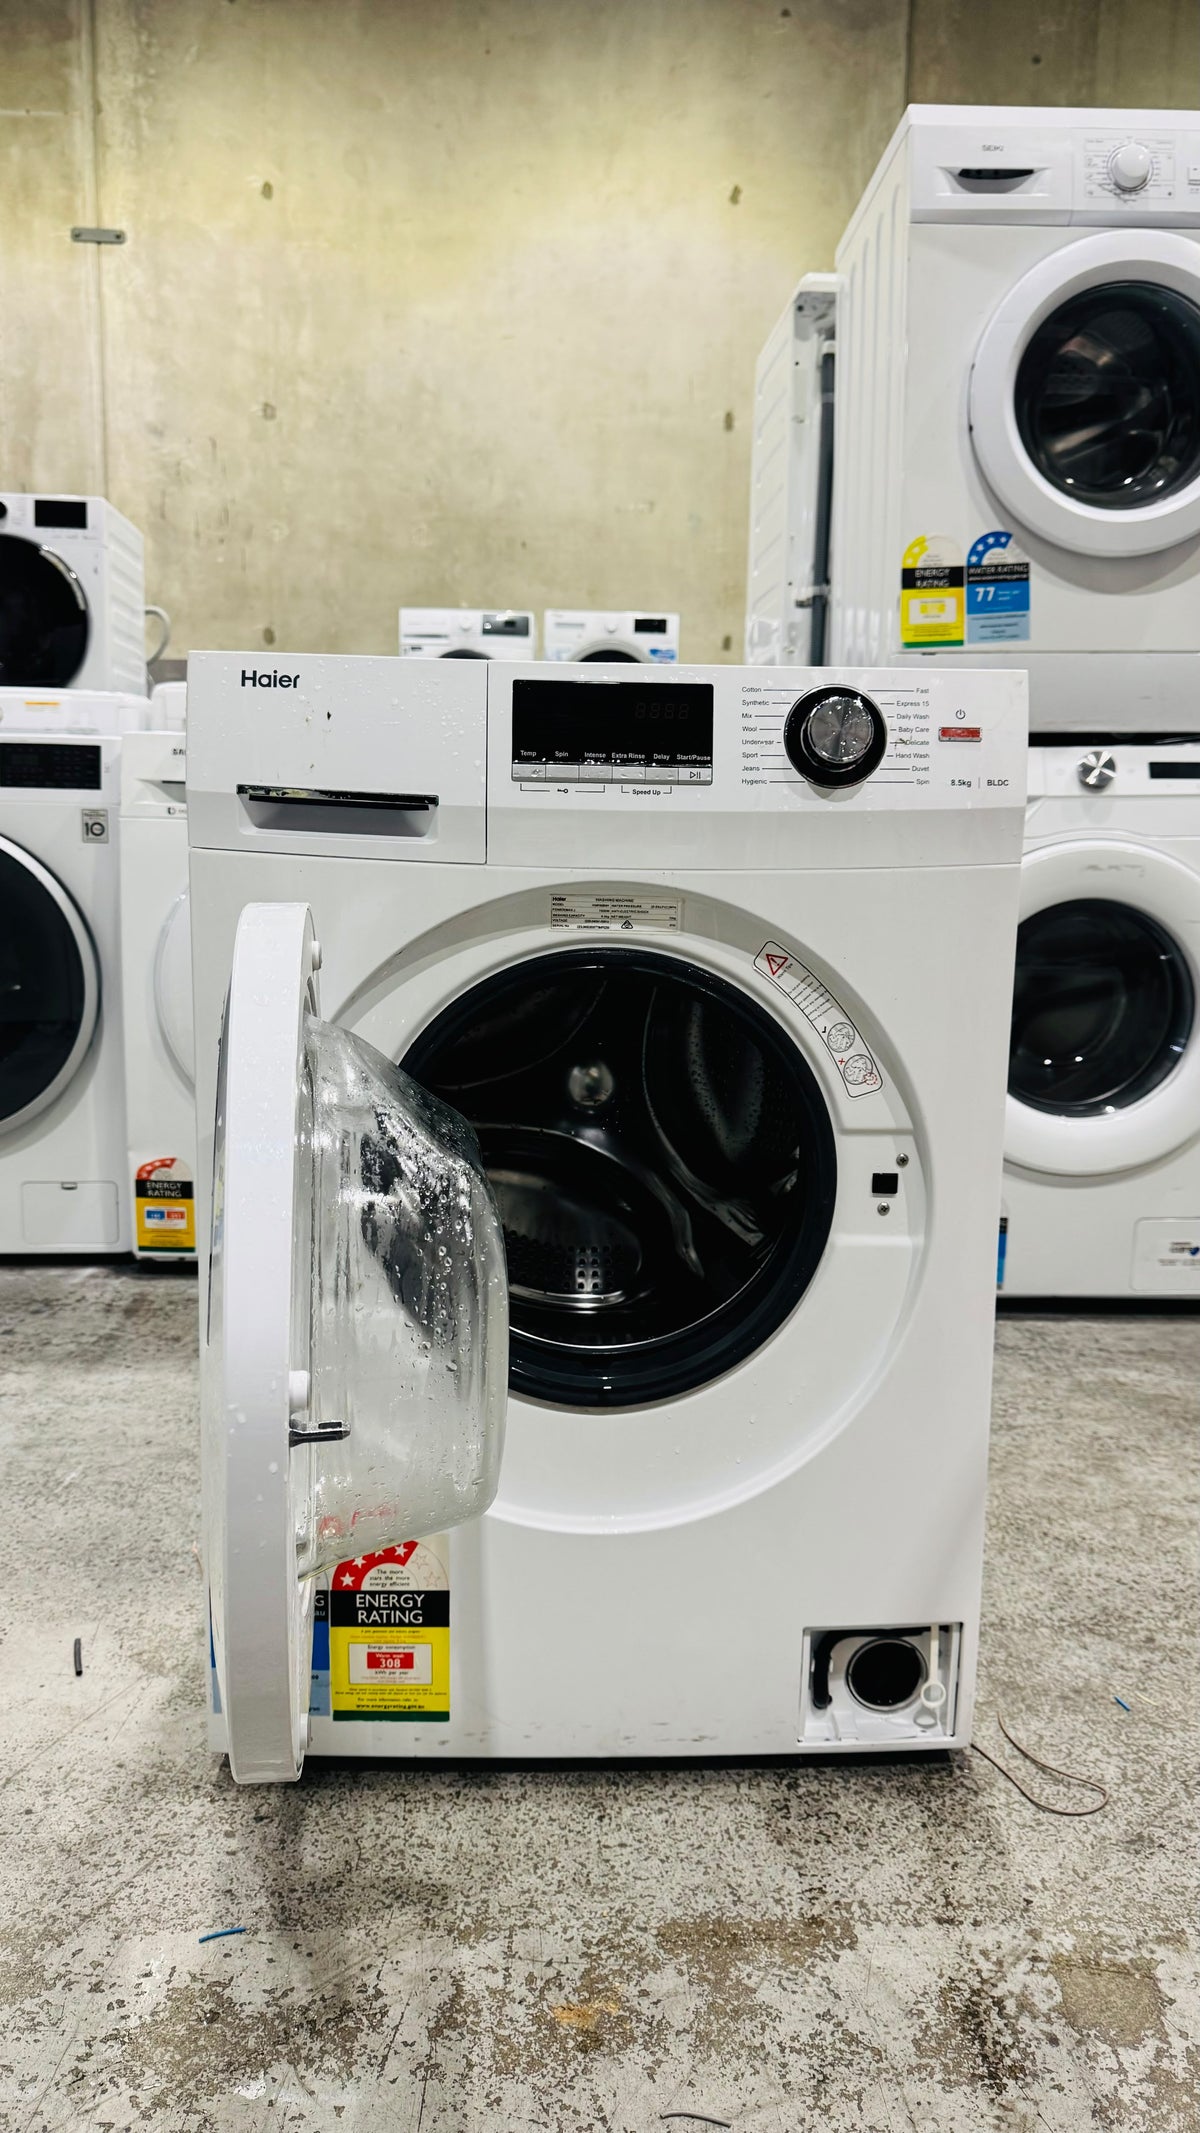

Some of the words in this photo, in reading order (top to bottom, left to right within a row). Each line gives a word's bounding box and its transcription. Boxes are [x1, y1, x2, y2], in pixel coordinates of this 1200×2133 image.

[915, 568, 950, 578] ENERGY
[975, 586, 996, 602] 77
[241, 670, 300, 689] Haier
[950, 778, 972, 788] 8.5kg
[986, 779, 1009, 788] BLDC
[146, 1181, 182, 1190] ENERGY
[356, 1594, 424, 1608] ENERGY
[358, 1610, 423, 1624] RATING
[380, 1658, 400, 1668] 308
